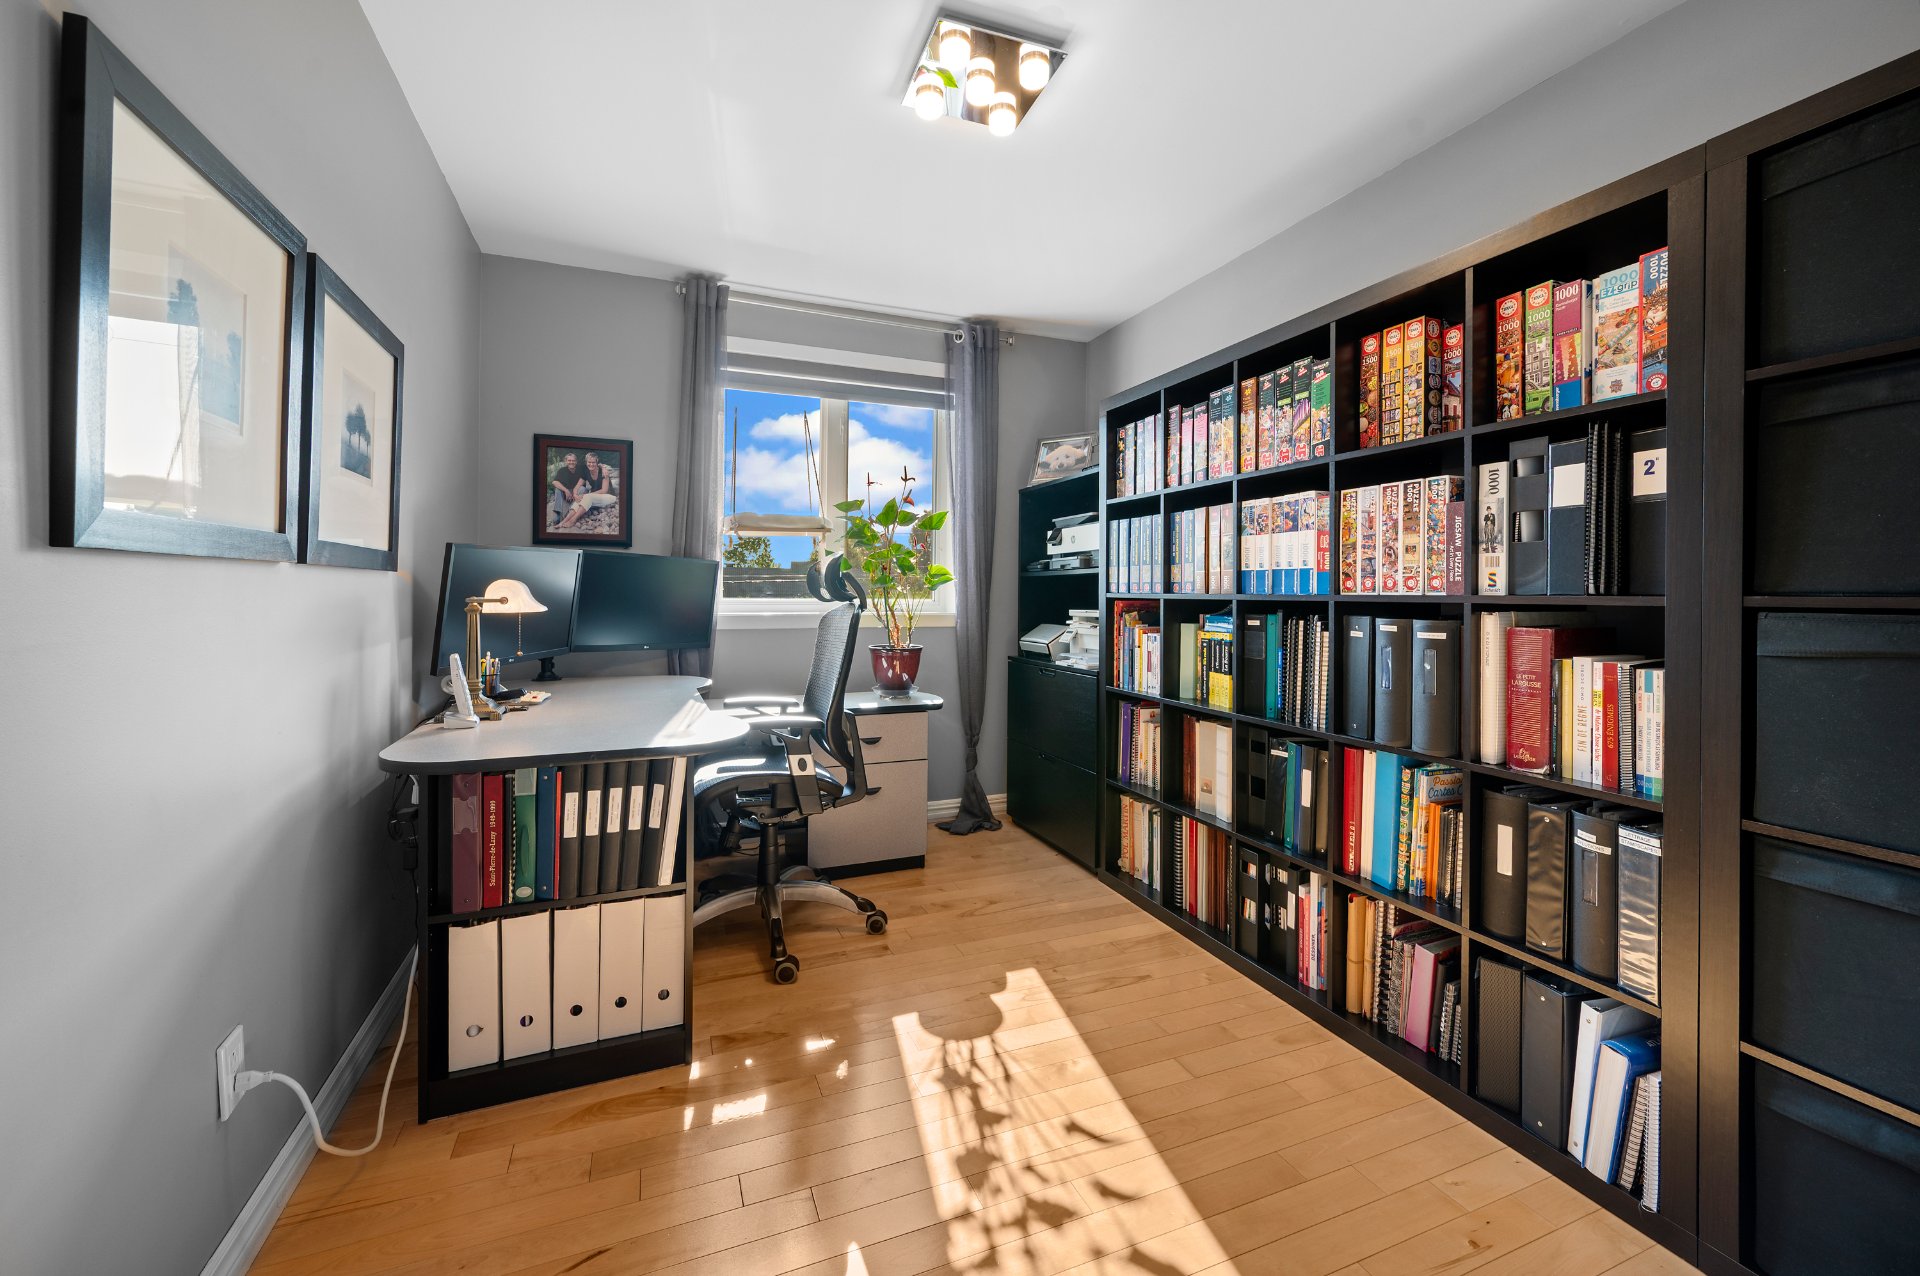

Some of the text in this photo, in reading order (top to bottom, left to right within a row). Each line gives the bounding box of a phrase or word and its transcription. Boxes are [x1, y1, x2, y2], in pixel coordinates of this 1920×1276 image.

[1650, 256, 1658, 279] 1000
[1660, 252, 1668, 289] PUZZLE
[1604, 270, 1638, 288] 1000
[1556, 284, 1578, 302] 1000
[1528, 310, 1550, 324] 1000
[1498, 320, 1520, 334] 1000
[1362, 356, 1378, 366] 1500
[1444, 349, 1462, 360] 1000
[1488, 468, 1500, 494] 1000
[1512, 680, 1542, 689] LAROUSSE
[1578, 730, 1587, 738] DE
[1578, 742, 1587, 753] FIN
[1625, 831, 1650, 843] LETTRAGE
